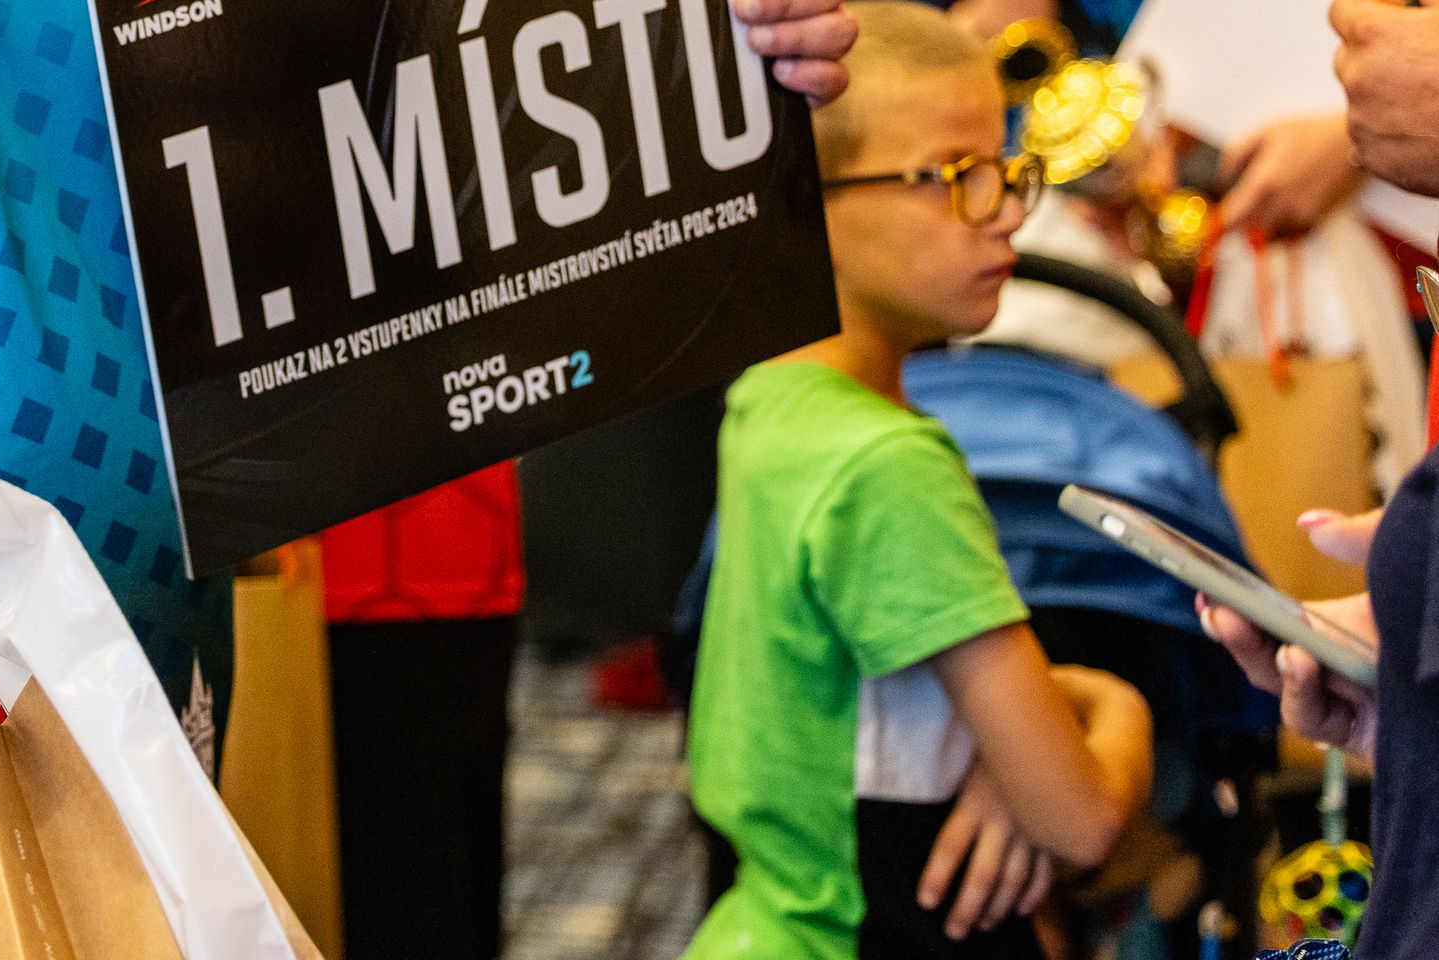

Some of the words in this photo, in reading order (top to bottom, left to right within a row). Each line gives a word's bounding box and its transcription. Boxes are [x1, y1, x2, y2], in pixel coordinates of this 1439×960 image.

[162, 125, 296, 348] 1.
[238, 351, 309, 400] POUKAZ
[307, 342, 335, 375] NA
[334, 336, 349, 366] 2
[347, 302, 444, 360] VSTUPENKY
[445, 293, 472, 327] NA
[470, 272, 528, 317] FINÁLE
[527, 228, 634, 296] MISTROVSTVÍ
[633, 218, 683, 259] SVĚTA
[681, 206, 716, 242] PDC
[715, 191, 758, 231] 2024
[442, 353, 507, 394] nova
[447, 350, 594, 432] SPORT2
